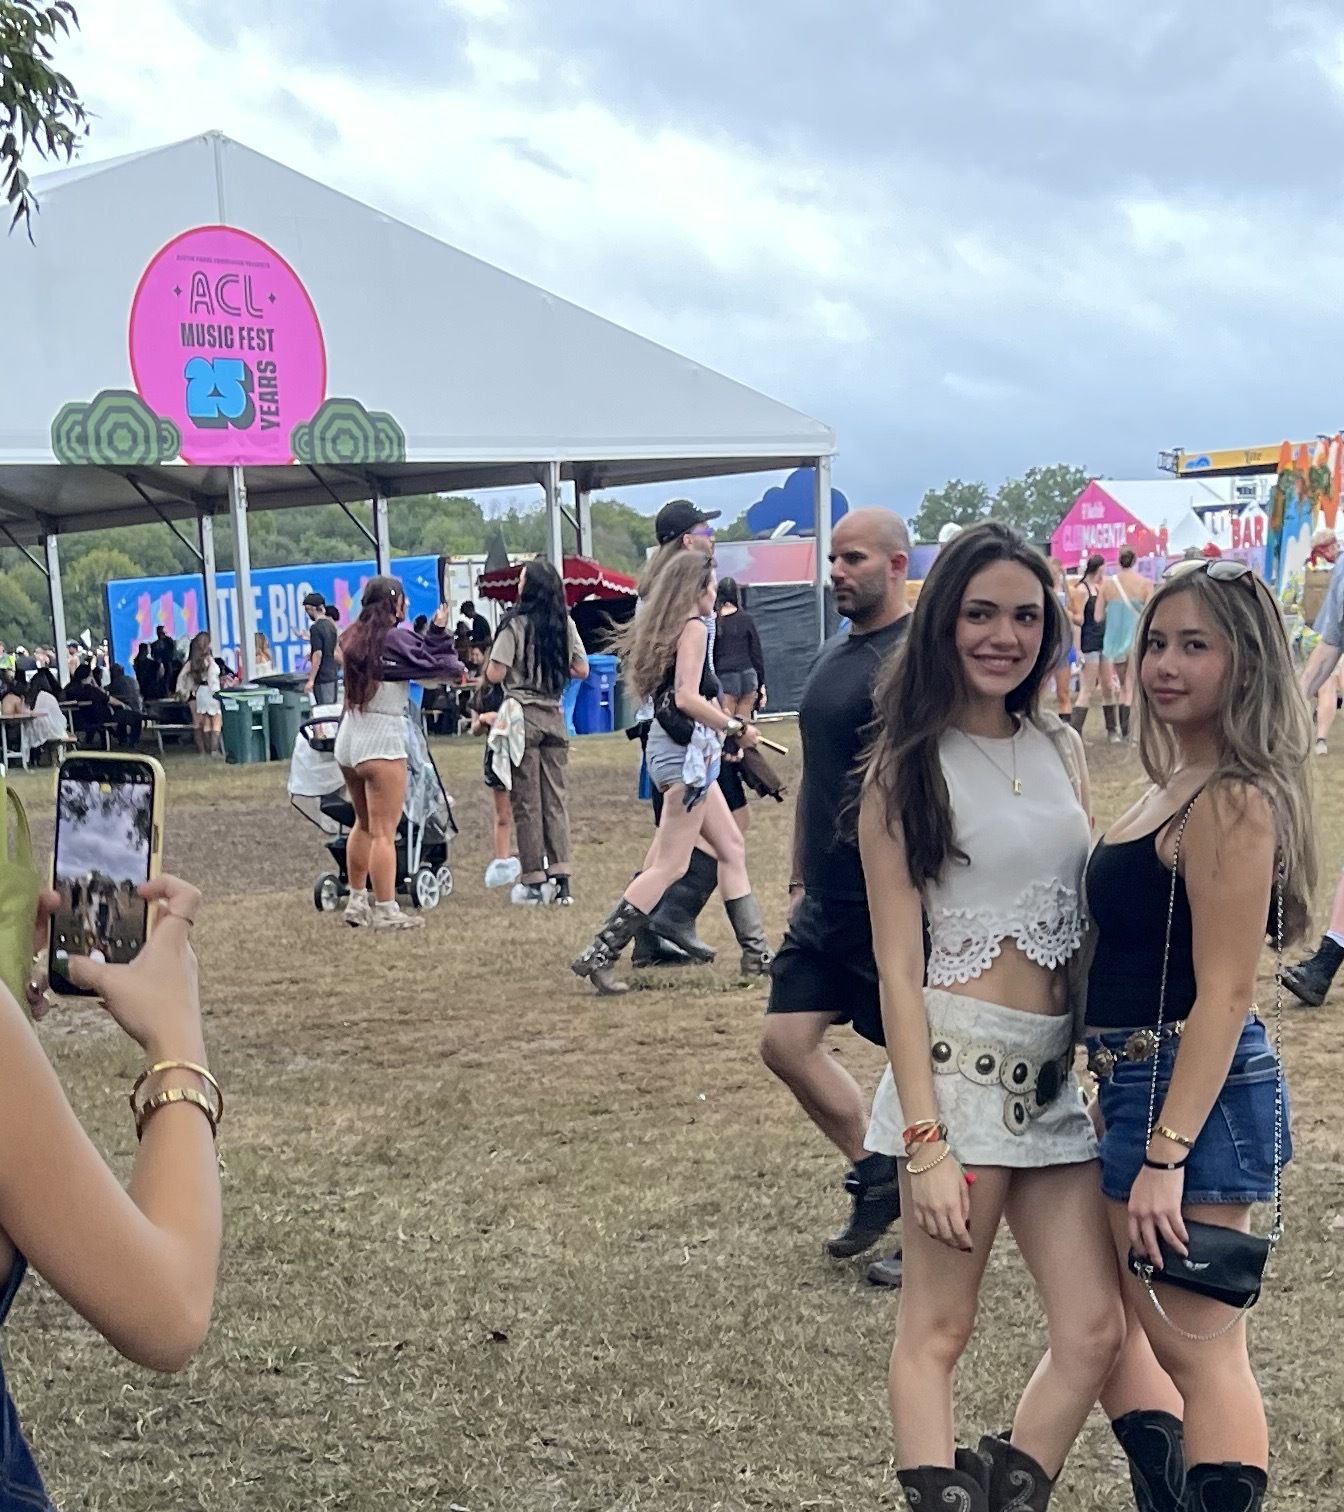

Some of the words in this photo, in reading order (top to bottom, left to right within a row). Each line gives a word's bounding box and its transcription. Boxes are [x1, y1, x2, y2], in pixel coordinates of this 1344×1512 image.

[190, 270, 263, 319] ACL
[181, 322, 234, 348] MUSIC
[238, 326, 275, 352] FEST
[184, 356, 255, 430] 25
[256, 360, 280, 430] YEARS
[1231, 515, 1265, 549] BAR
